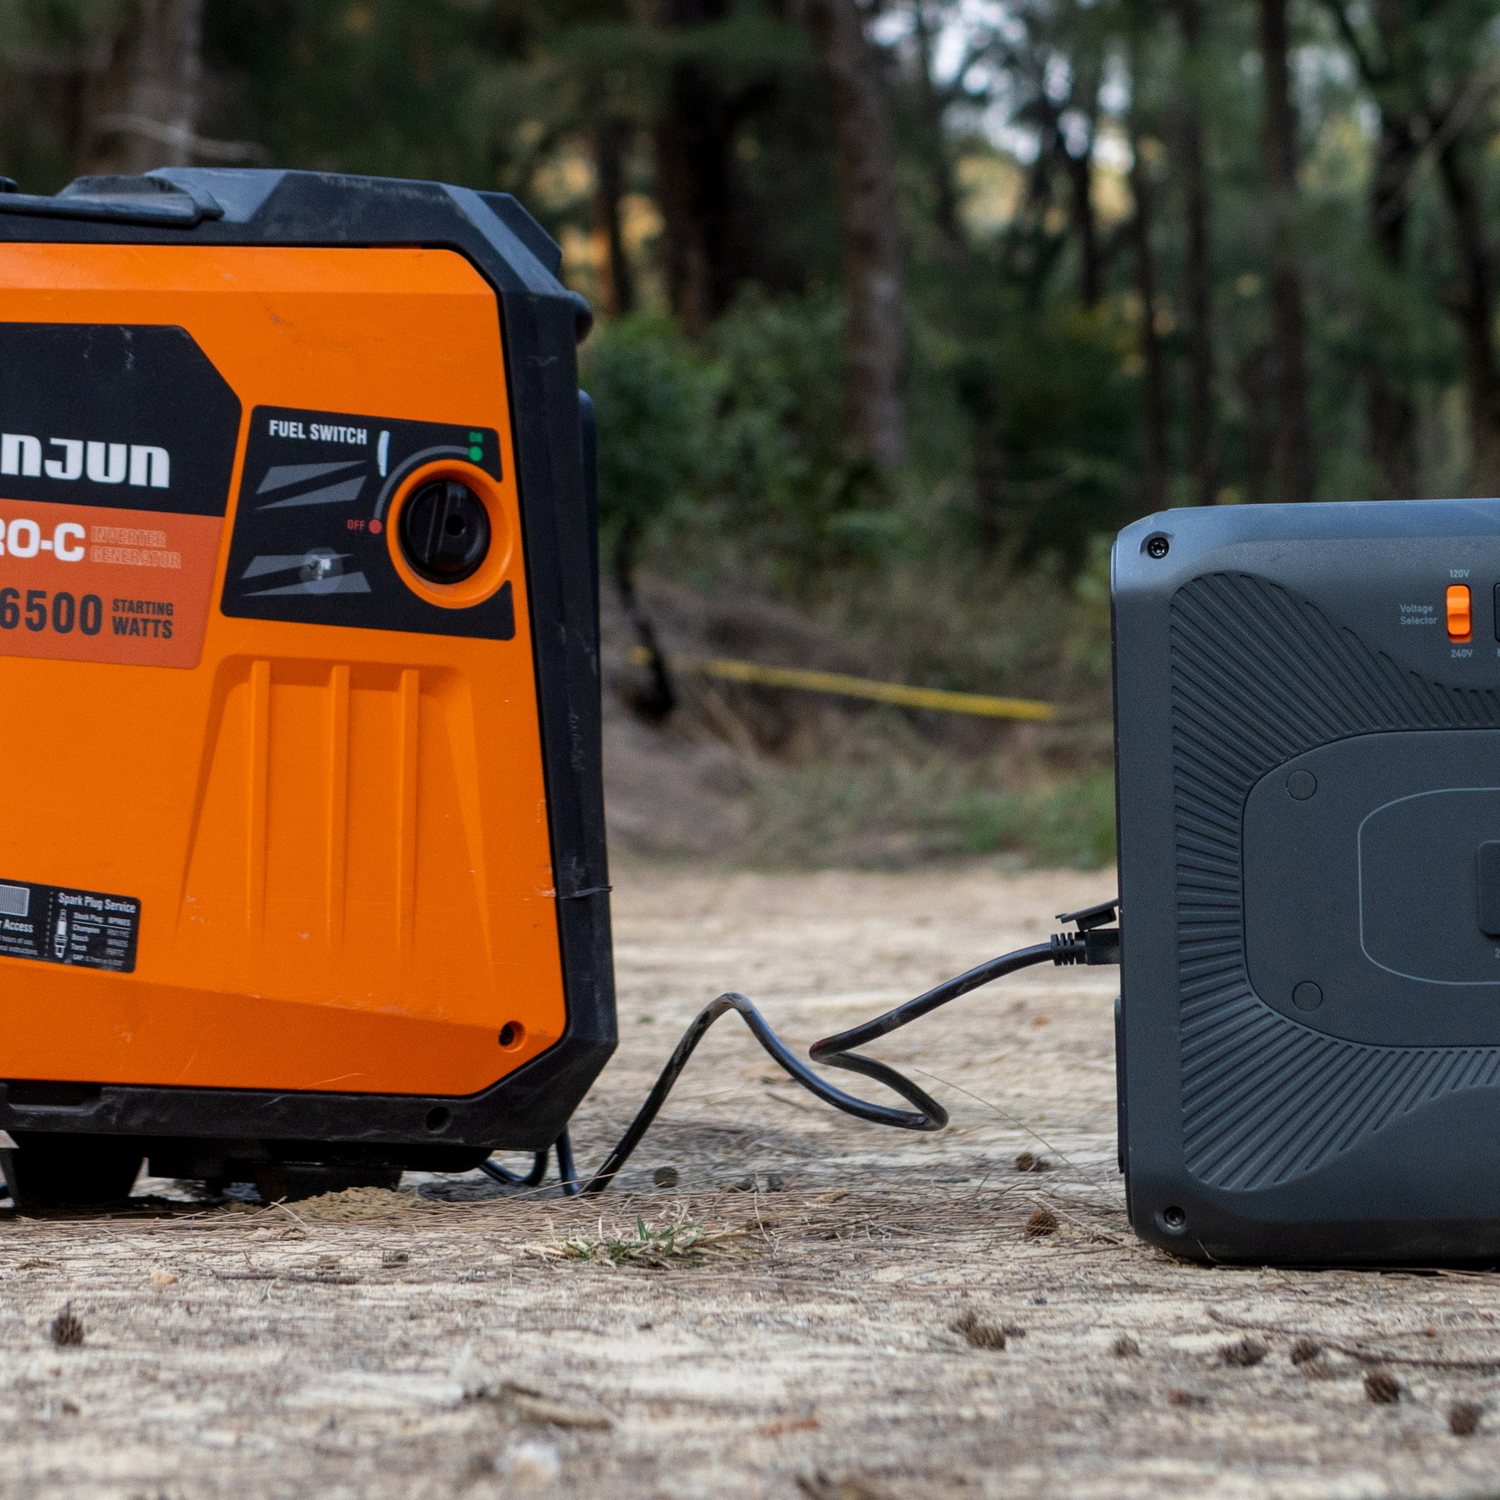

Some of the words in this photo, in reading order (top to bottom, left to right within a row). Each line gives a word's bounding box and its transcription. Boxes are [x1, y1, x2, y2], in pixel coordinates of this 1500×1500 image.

[269, 419, 306, 440] FUEL
[310, 422, 368, 445] SWITCH
[347, 518, 366, 530] OFF
[91, 525, 166, 549] INVERTER
[91, 545, 181, 569] GENERATOR
[1449, 569, 1470, 578] 120V
[112, 598, 174, 616] STARTING
[1400, 604, 1434, 614] Voltage
[111, 615, 173, 639] WATTS
[1400, 616, 1438, 625] Selector
[1451, 649, 1473, 658] 240V
[58, 892, 83, 907] Spark
[84, 895, 103, 911] Plug
[104, 899, 137, 914] Service
[3, 918, 34, 933] Access
